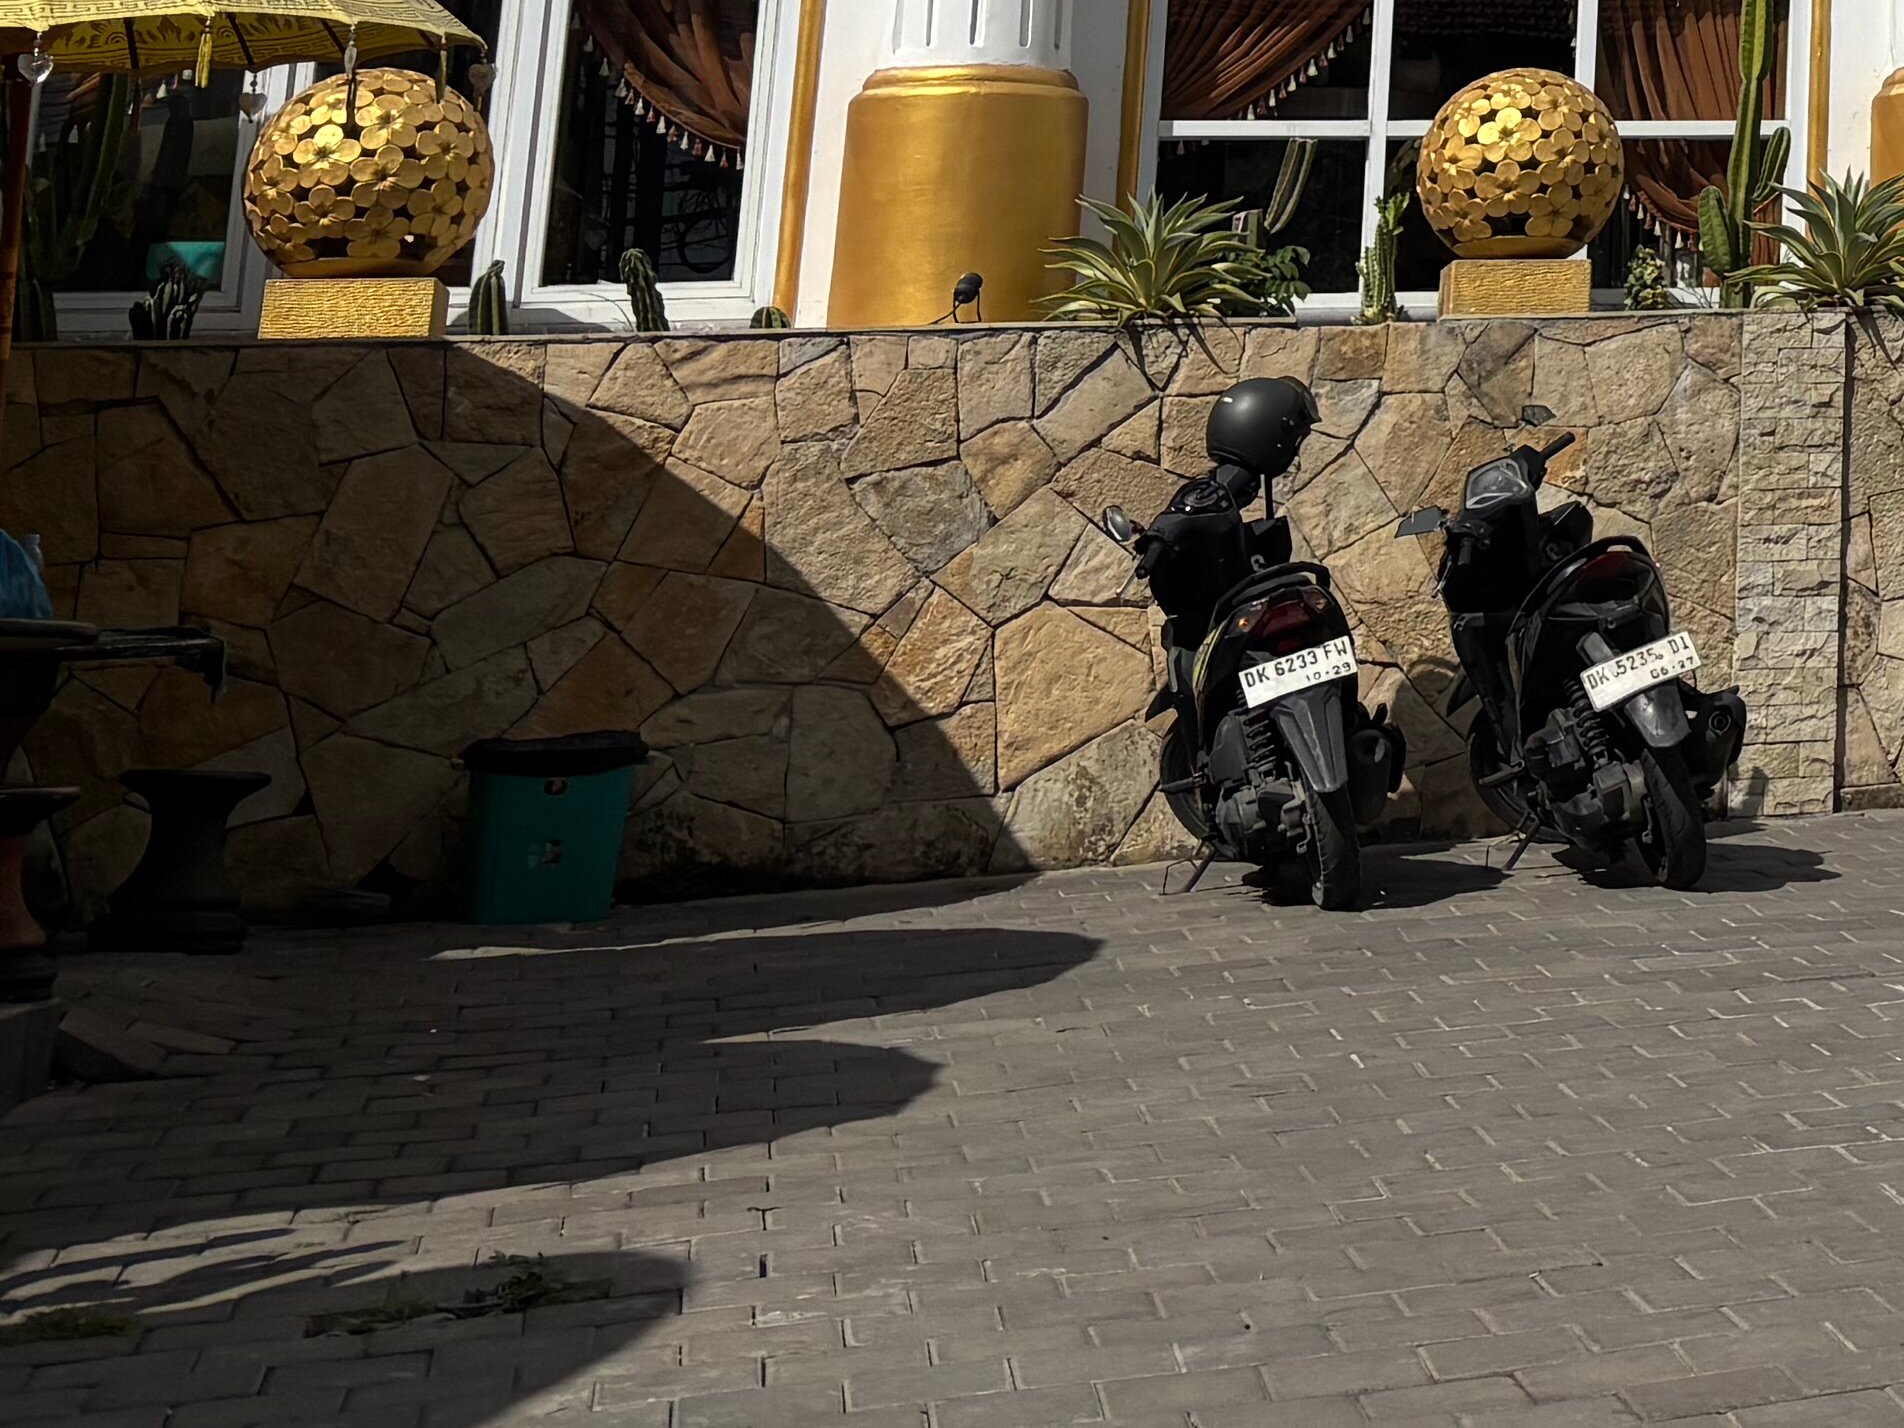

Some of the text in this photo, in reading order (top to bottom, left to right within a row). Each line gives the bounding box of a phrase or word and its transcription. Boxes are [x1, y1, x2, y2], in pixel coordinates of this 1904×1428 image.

[1244, 640, 1348, 688] DK 6233 FW
[1586, 666, 1610, 690] DK
[1614, 647, 1662, 677] 5235
